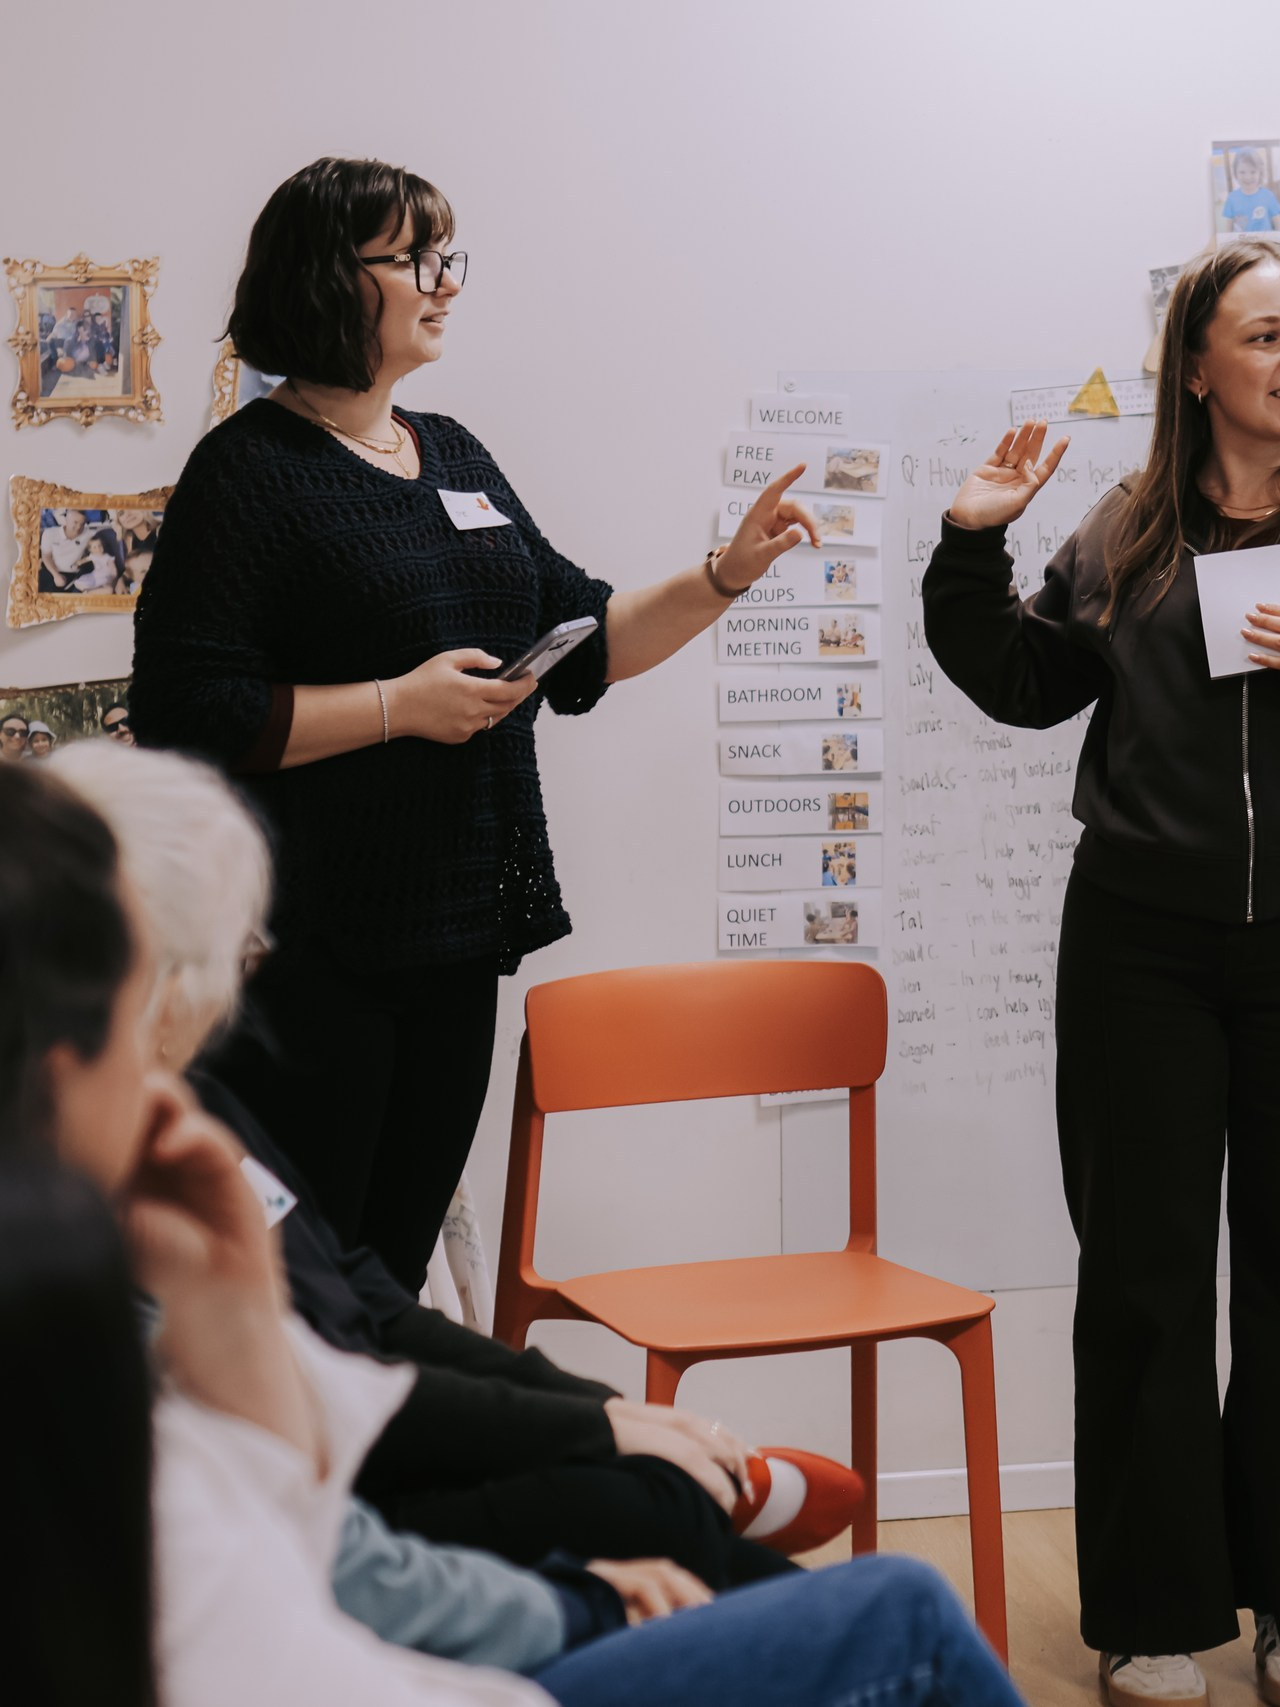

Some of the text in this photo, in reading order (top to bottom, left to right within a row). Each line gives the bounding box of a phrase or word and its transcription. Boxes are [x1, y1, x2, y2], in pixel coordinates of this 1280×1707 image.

[759, 408, 844, 426] WELCOME
[735, 445, 776, 462] FREE
[733, 468, 772, 485] PLAY
[727, 616, 810, 633] MORNING
[727, 641, 802, 657] MEETING
[727, 686, 823, 704] BATHROOM
[727, 744, 782, 759] SNACK
[727, 797, 822, 814] OUTDOORS
[727, 853, 783, 869] LUNCH
[726, 907, 777, 924] QUIET
[894, 909, 923, 931] Tal
[726, 932, 768, 948] TIME
